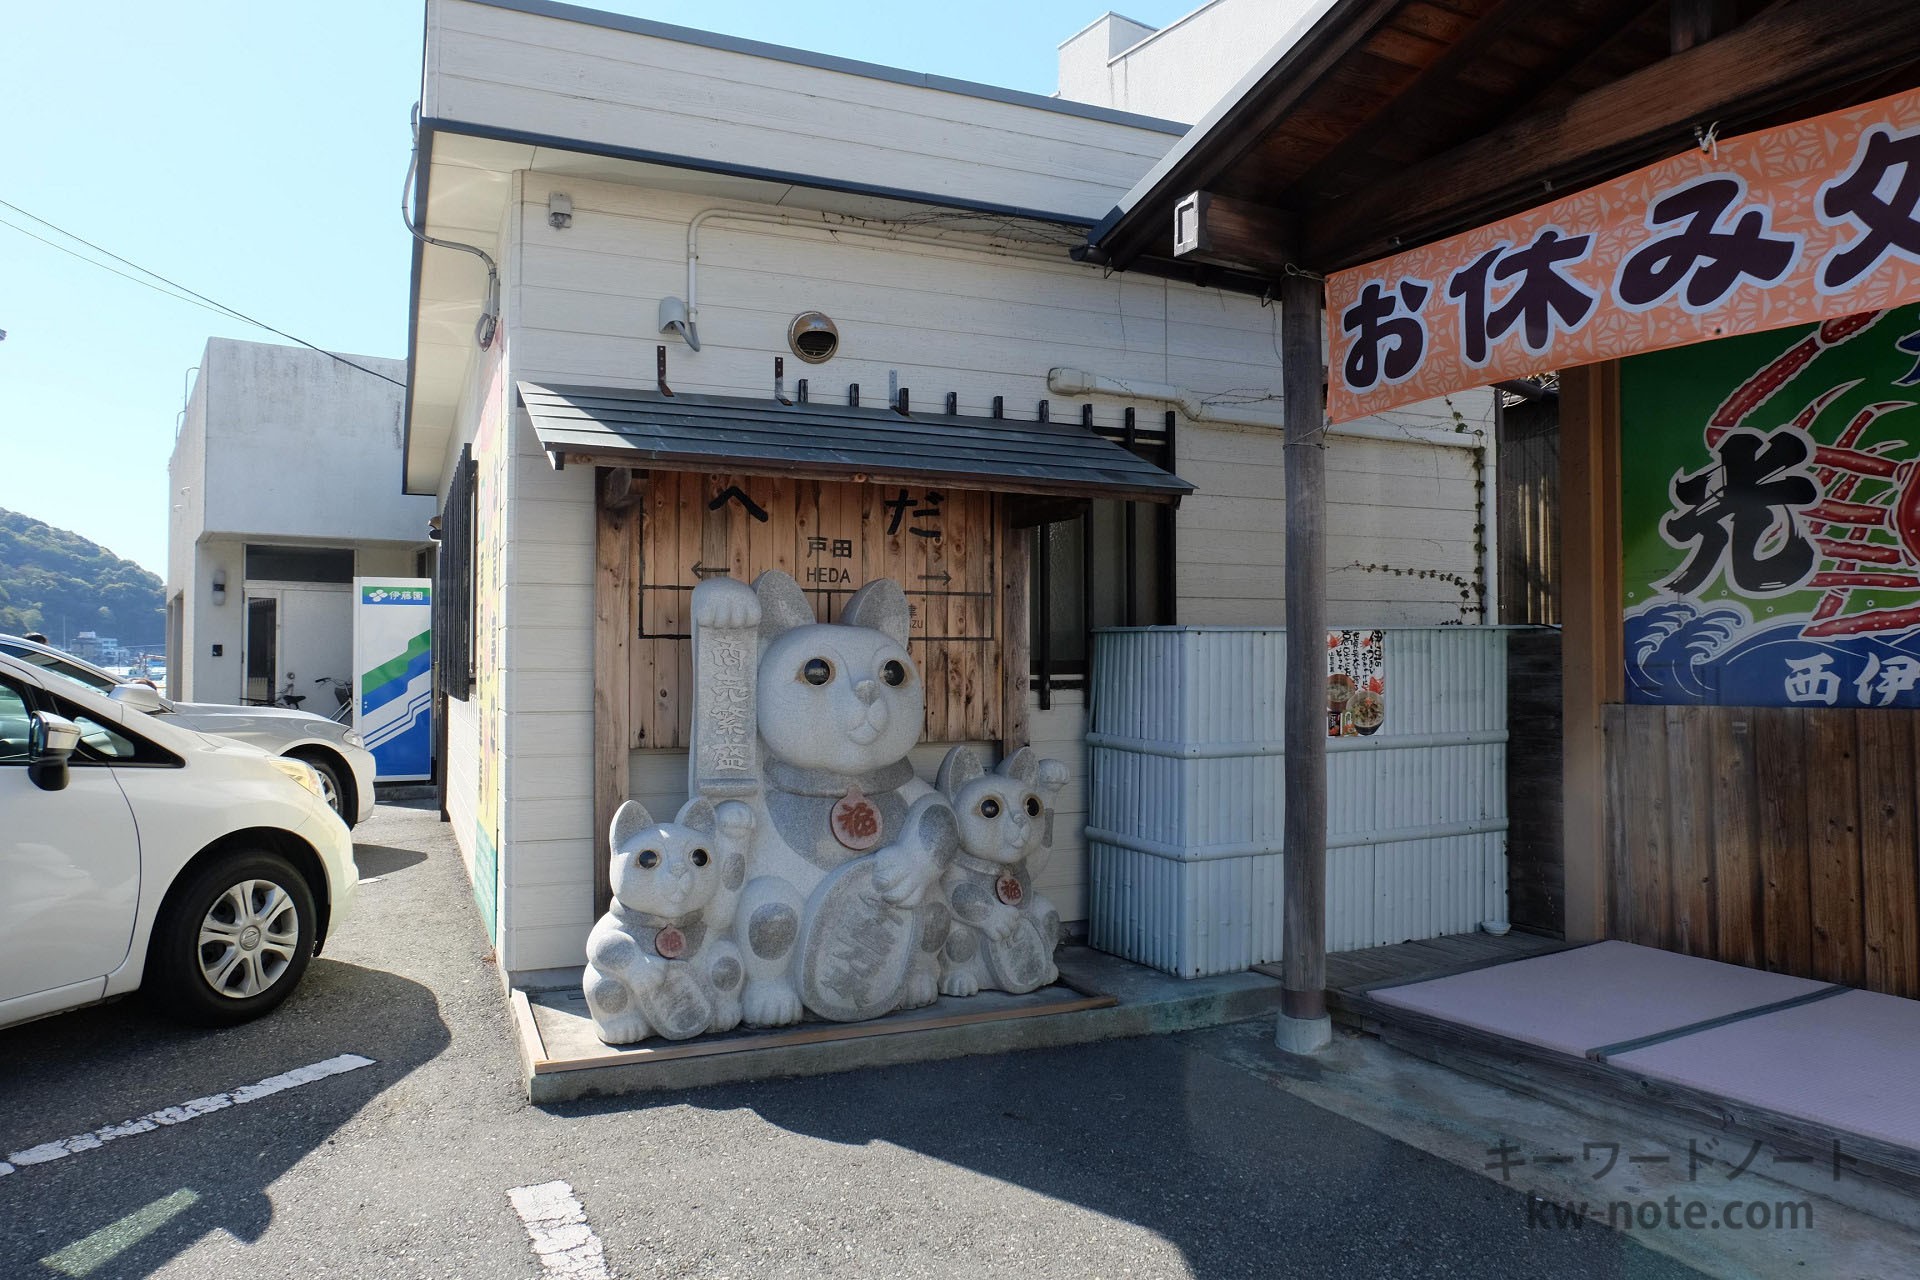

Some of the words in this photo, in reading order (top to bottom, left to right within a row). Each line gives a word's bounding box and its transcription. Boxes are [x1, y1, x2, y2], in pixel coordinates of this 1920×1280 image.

[1655, 427, 1822, 598] 光
[807, 536, 852, 559] 戸田
[806, 567, 851, 584] HEDA
[389, 590, 423, 601] 伊藤園
